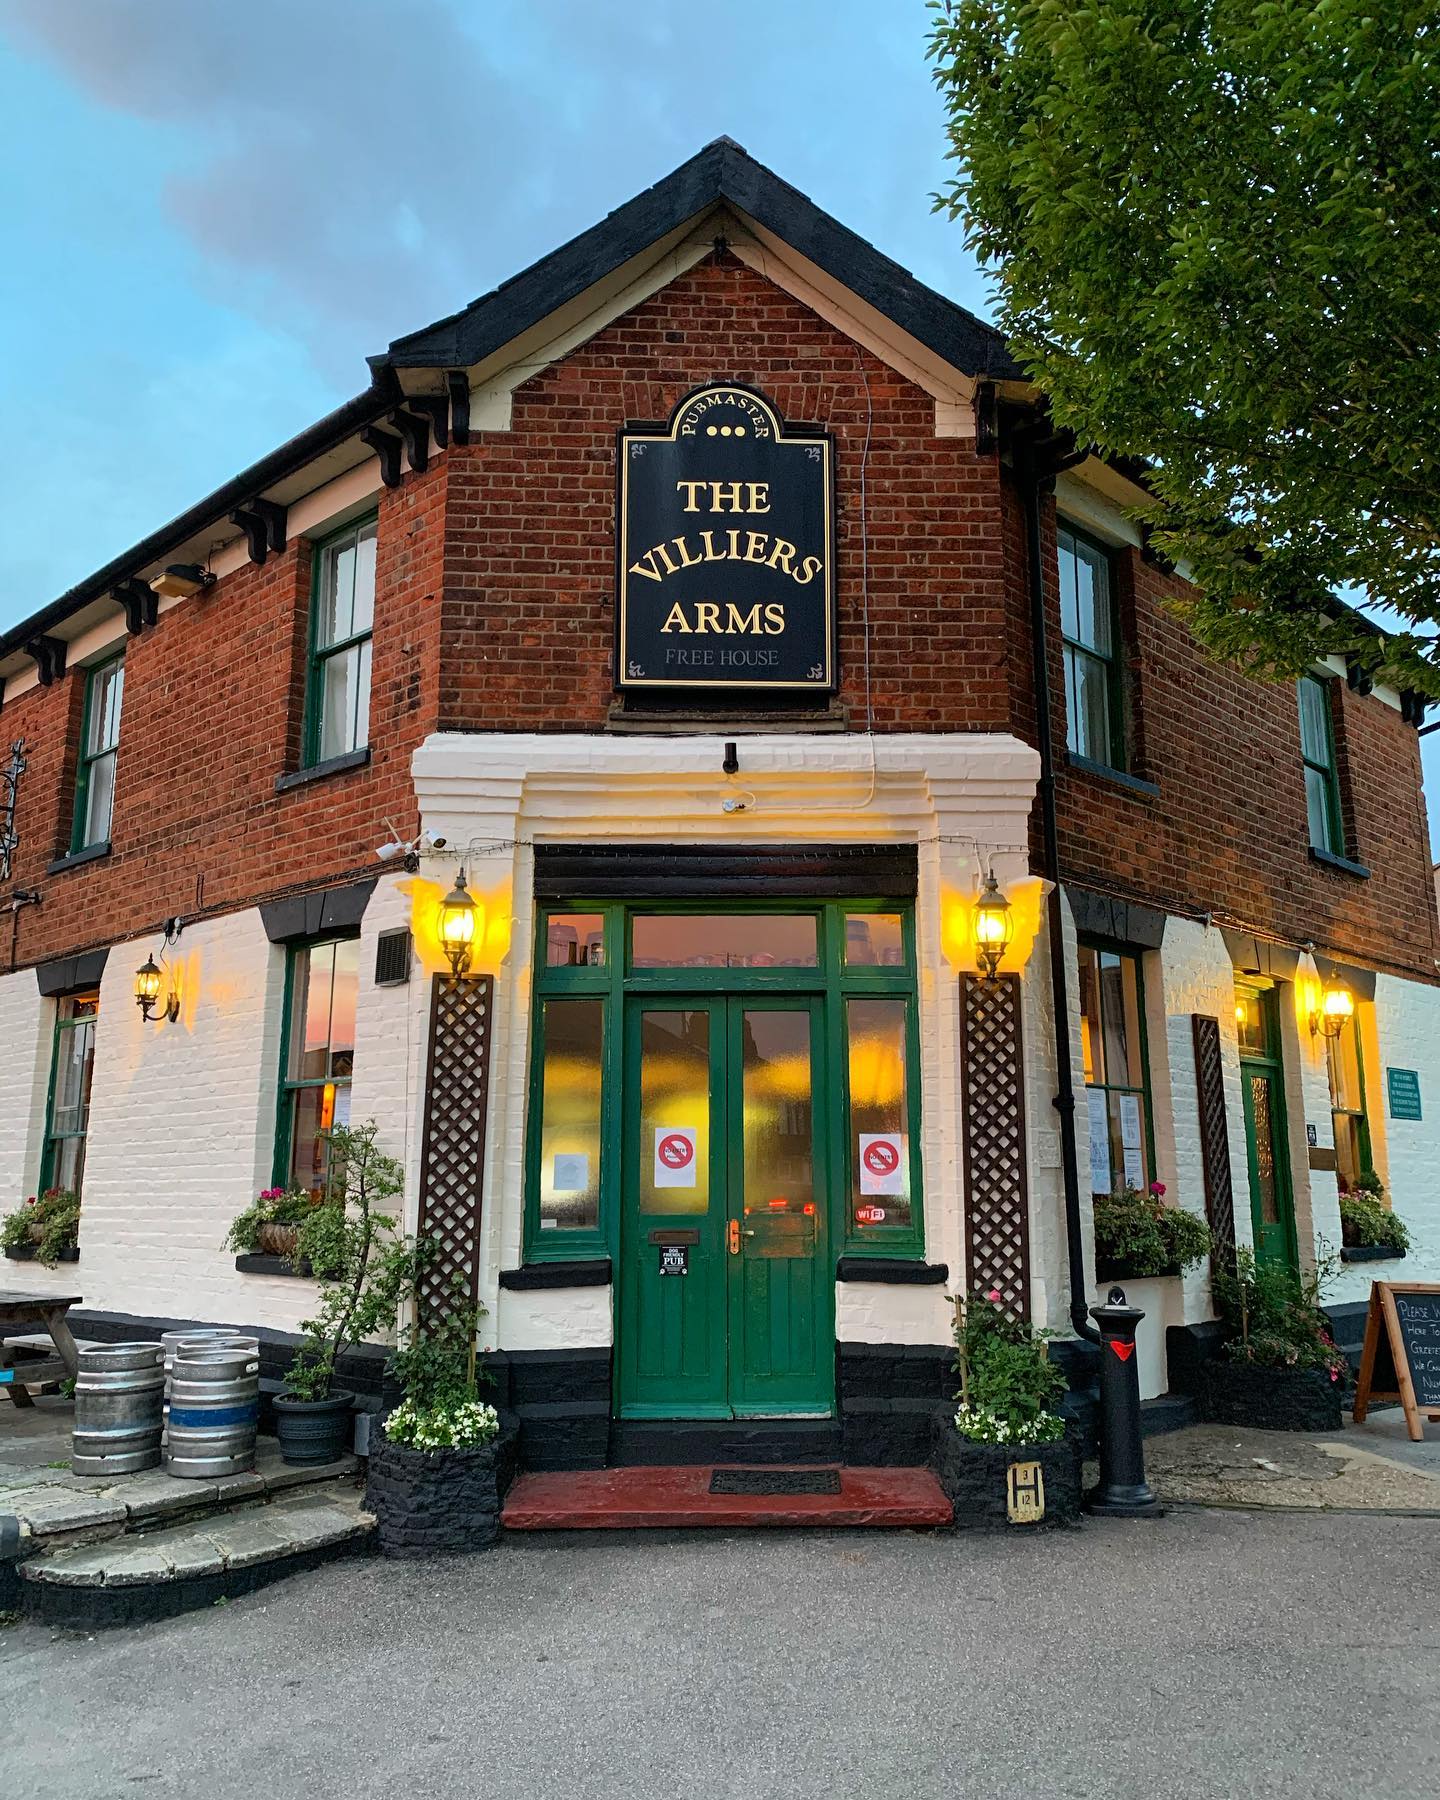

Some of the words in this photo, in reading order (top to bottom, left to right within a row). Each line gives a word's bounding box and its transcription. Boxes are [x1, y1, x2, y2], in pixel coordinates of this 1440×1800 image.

[682, 393, 769, 438] PUBMASTER
[677, 481, 771, 513] THE
[629, 530, 823, 584] VILLIERS
[660, 602, 785, 635] ARMS
[665, 649, 715, 666] FREE
[720, 650, 779, 666] HOUSE
[663, 1257, 684, 1265] PUB
[1012, 1466, 1039, 1509] H
[1023, 1469, 1029, 1480] 3
[1022, 1494, 1031, 1505] 12
